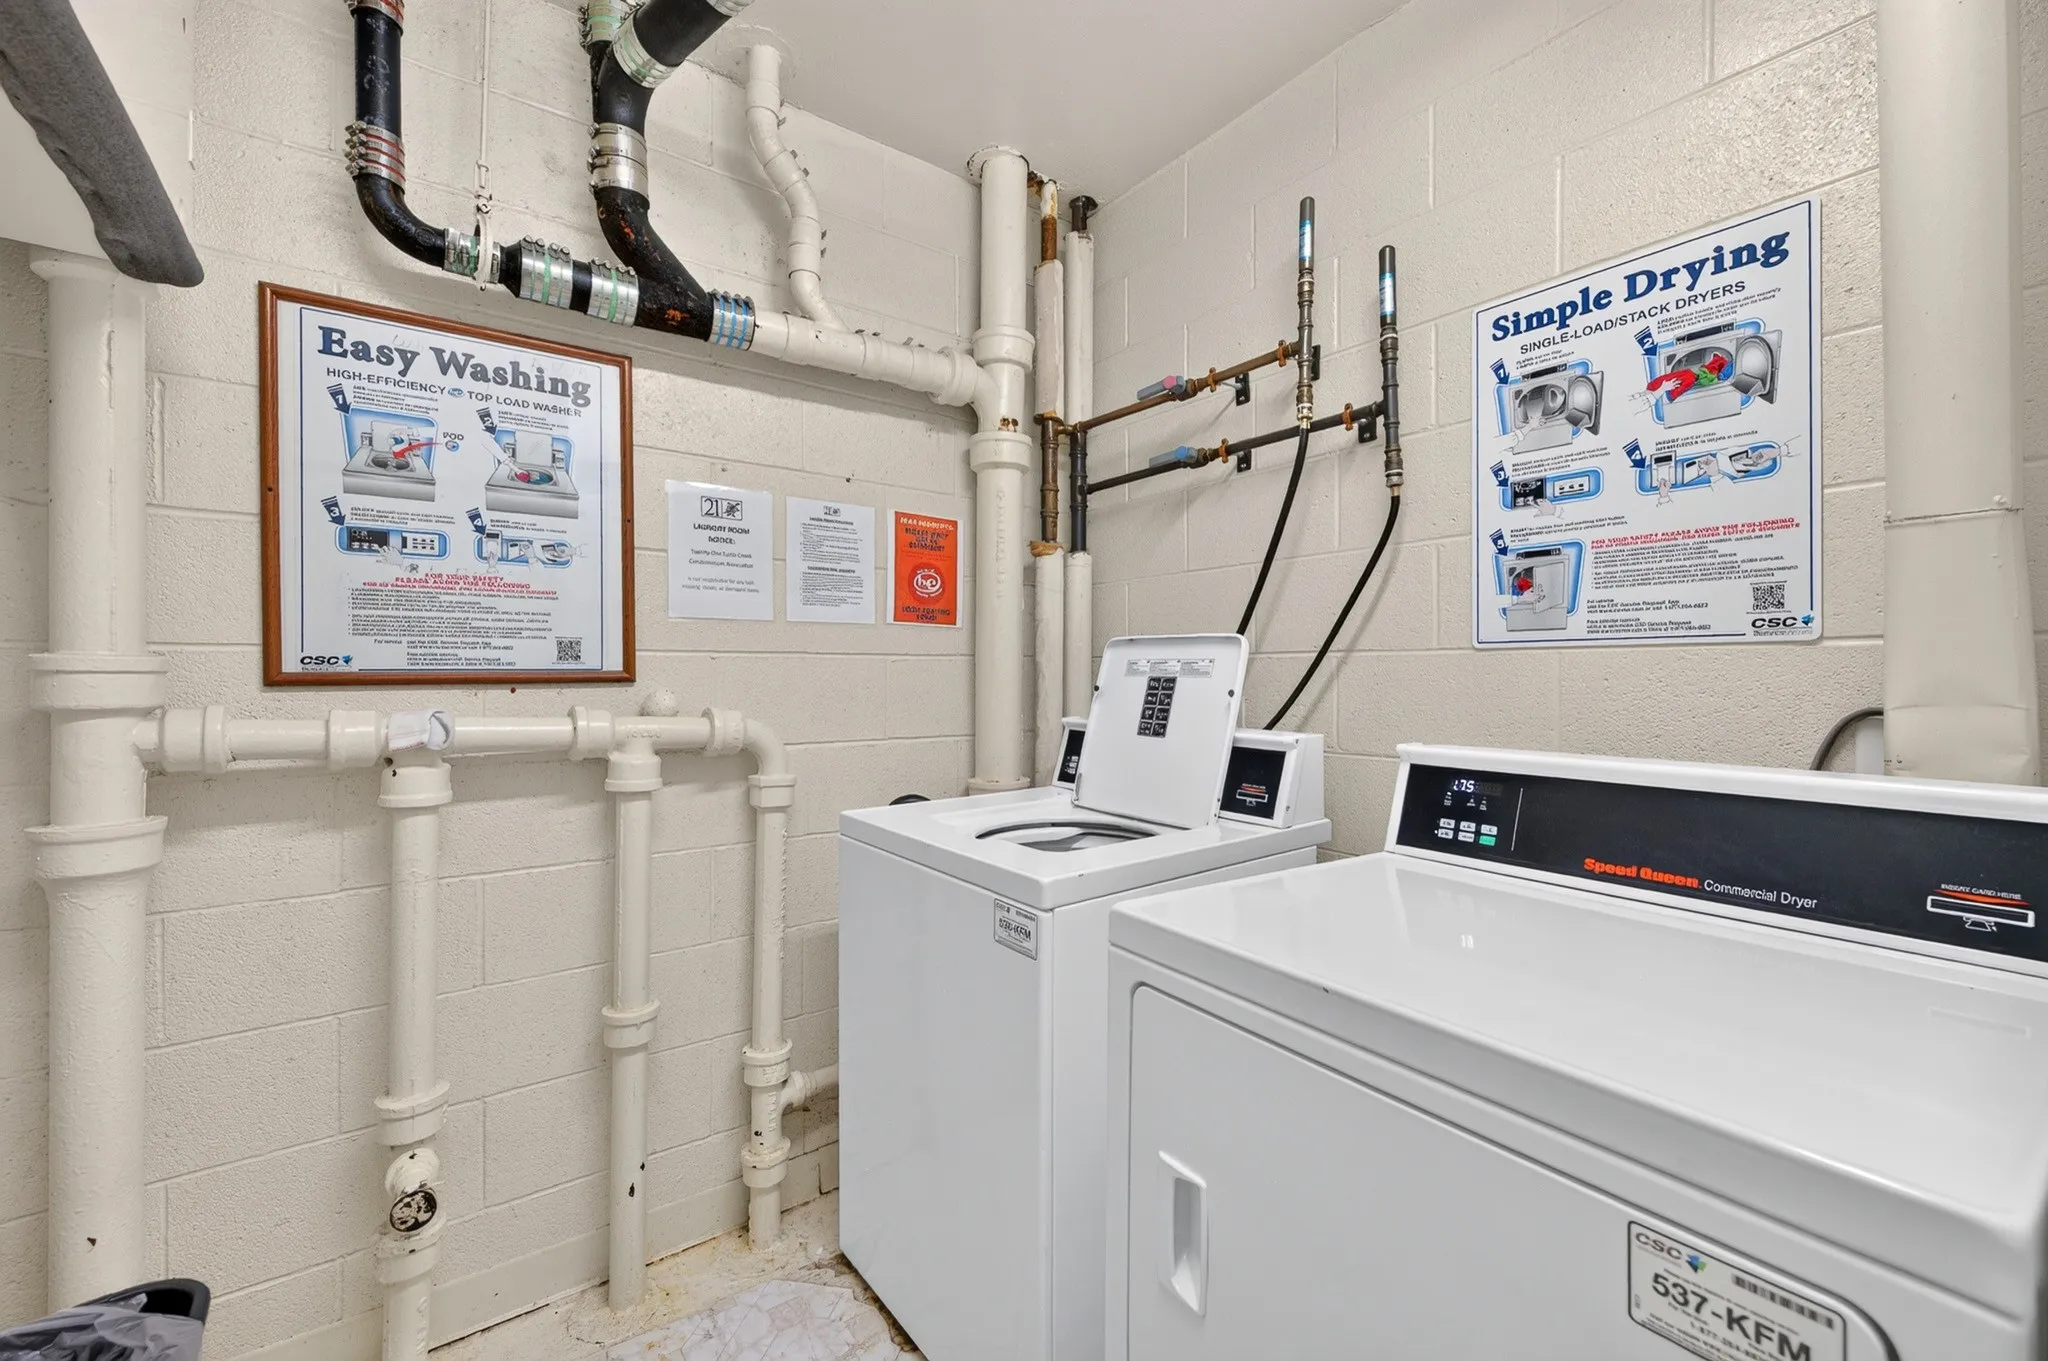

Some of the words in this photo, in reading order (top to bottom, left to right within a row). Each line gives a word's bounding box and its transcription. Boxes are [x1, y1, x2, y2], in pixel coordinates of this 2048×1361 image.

[1491, 285, 1613, 342] Simple
[1623, 231, 1790, 302] Drying
[1520, 303, 1672, 355] SINGLE-LOAD/STACK
[1675, 280, 1746, 311] DRYERS
[1642, 337, 1654, 349] 2
[317, 325, 420, 378] Easy
[429, 346, 591, 408] Washing
[327, 367, 446, 395] HIGH-EFFICIENCY
[467, 391, 493, 402] TOP
[496, 396, 530, 409] LOAD
[533, 402, 582, 417] WASHER
[443, 432, 464, 441] POD
[330, 507, 340, 517] 3
[704, 498, 720, 517] 21
[1751, 616, 1798, 628] CSC
[300, 655, 340, 666] CSC
[1584, 857, 1637, 878] Speed
[1640, 867, 1700, 888] Queen
[1704, 879, 1776, 902] Commercial
[1781, 892, 1818, 908] Dryer
[1636, 1233, 1682, 1260] CSC
[1652, 1272, 1811, 1361] 537-KFM
